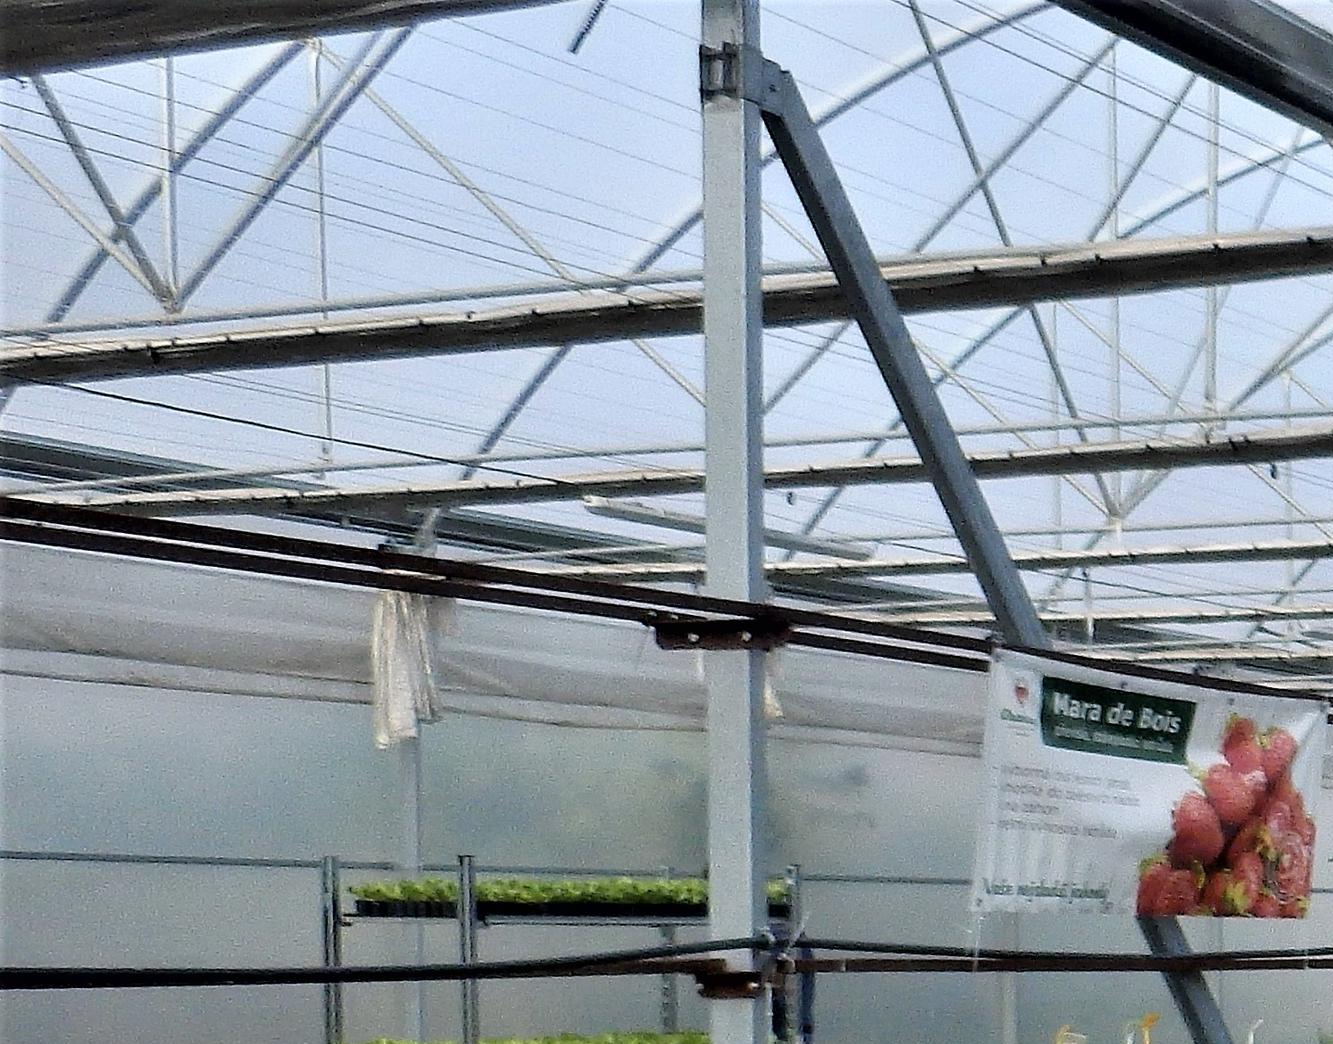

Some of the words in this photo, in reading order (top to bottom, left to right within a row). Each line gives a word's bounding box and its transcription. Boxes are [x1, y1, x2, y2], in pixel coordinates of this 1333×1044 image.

[1053, 691, 1102, 722] Mara
[1106, 702, 1134, 727] de
[1139, 707, 1181, 734] Bois
